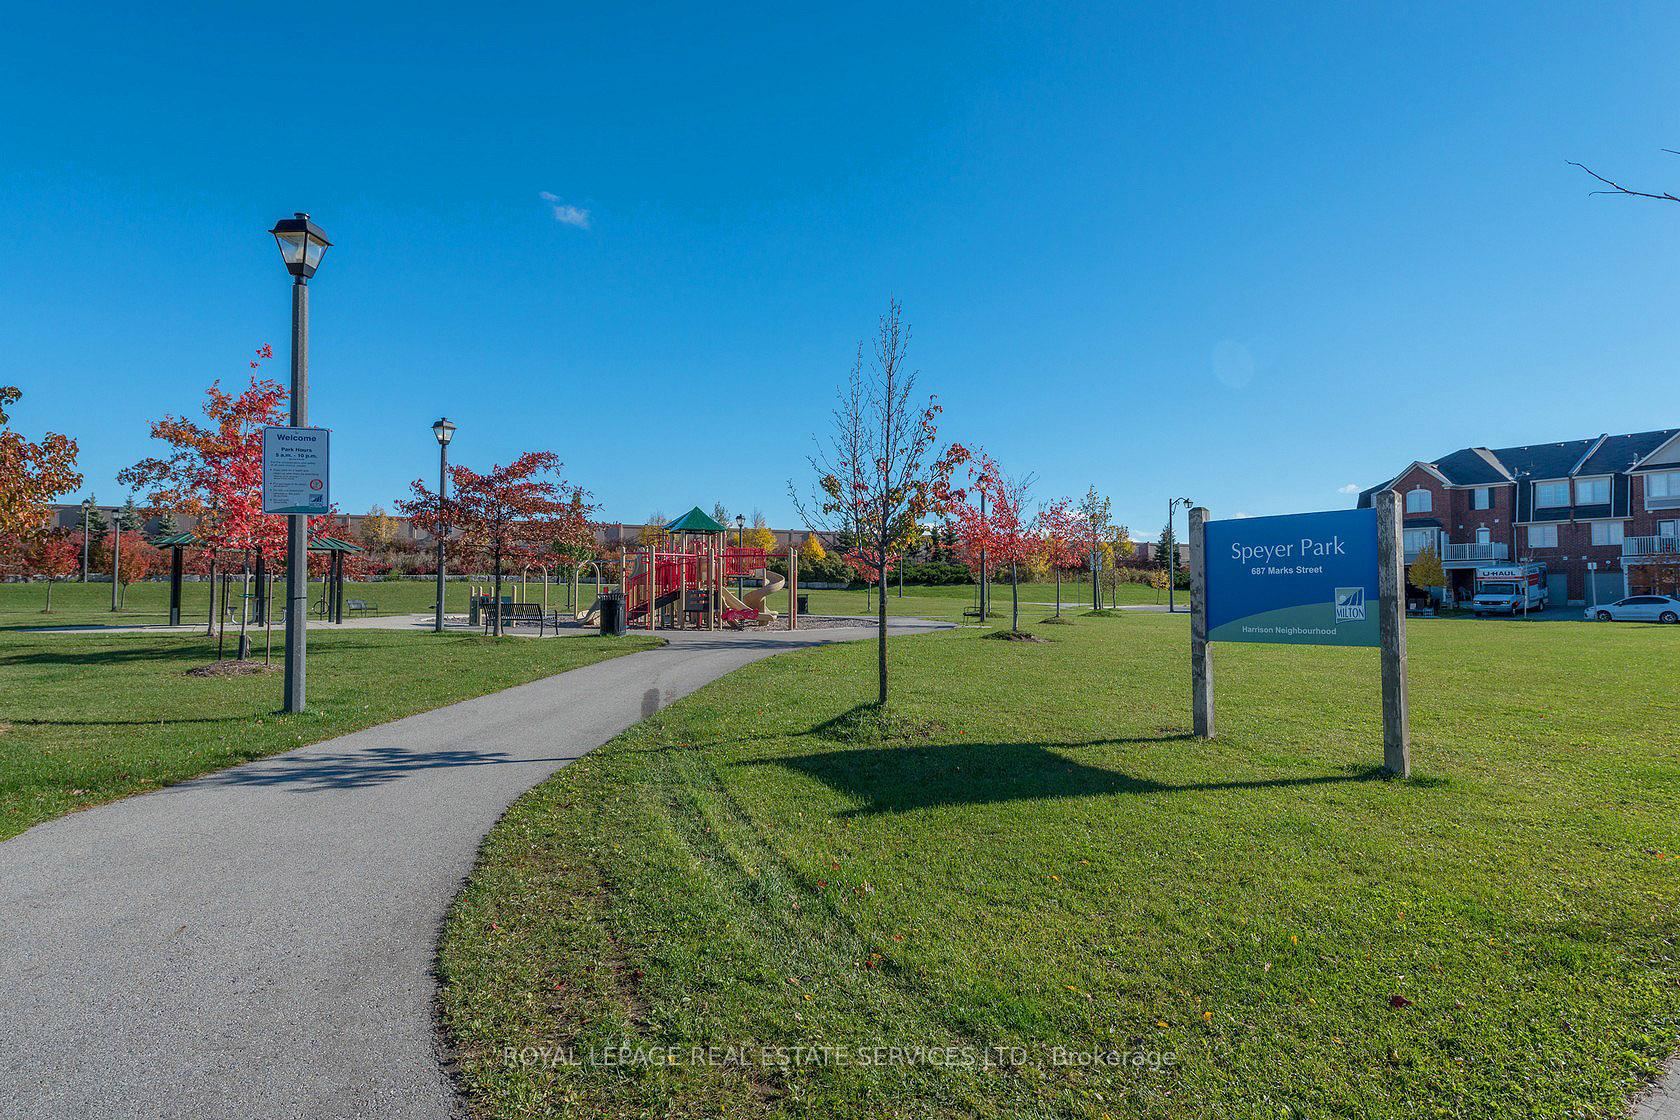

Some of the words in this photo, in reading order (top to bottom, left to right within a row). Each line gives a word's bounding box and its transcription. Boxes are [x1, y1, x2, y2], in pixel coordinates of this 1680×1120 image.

[277, 434, 317, 442] Welcome
[1231, 542, 1293, 564] Speyer
[1301, 536, 1345, 556] Park
[1251, 567, 1265, 575] 687
[1268, 566, 1294, 575] Marks
[1296, 565, 1323, 574] Street
[1336, 607, 1364, 619] MILTON
[1242, 626, 1273, 635] Harrison
[1275, 626, 1337, 636] Neighbourhood
